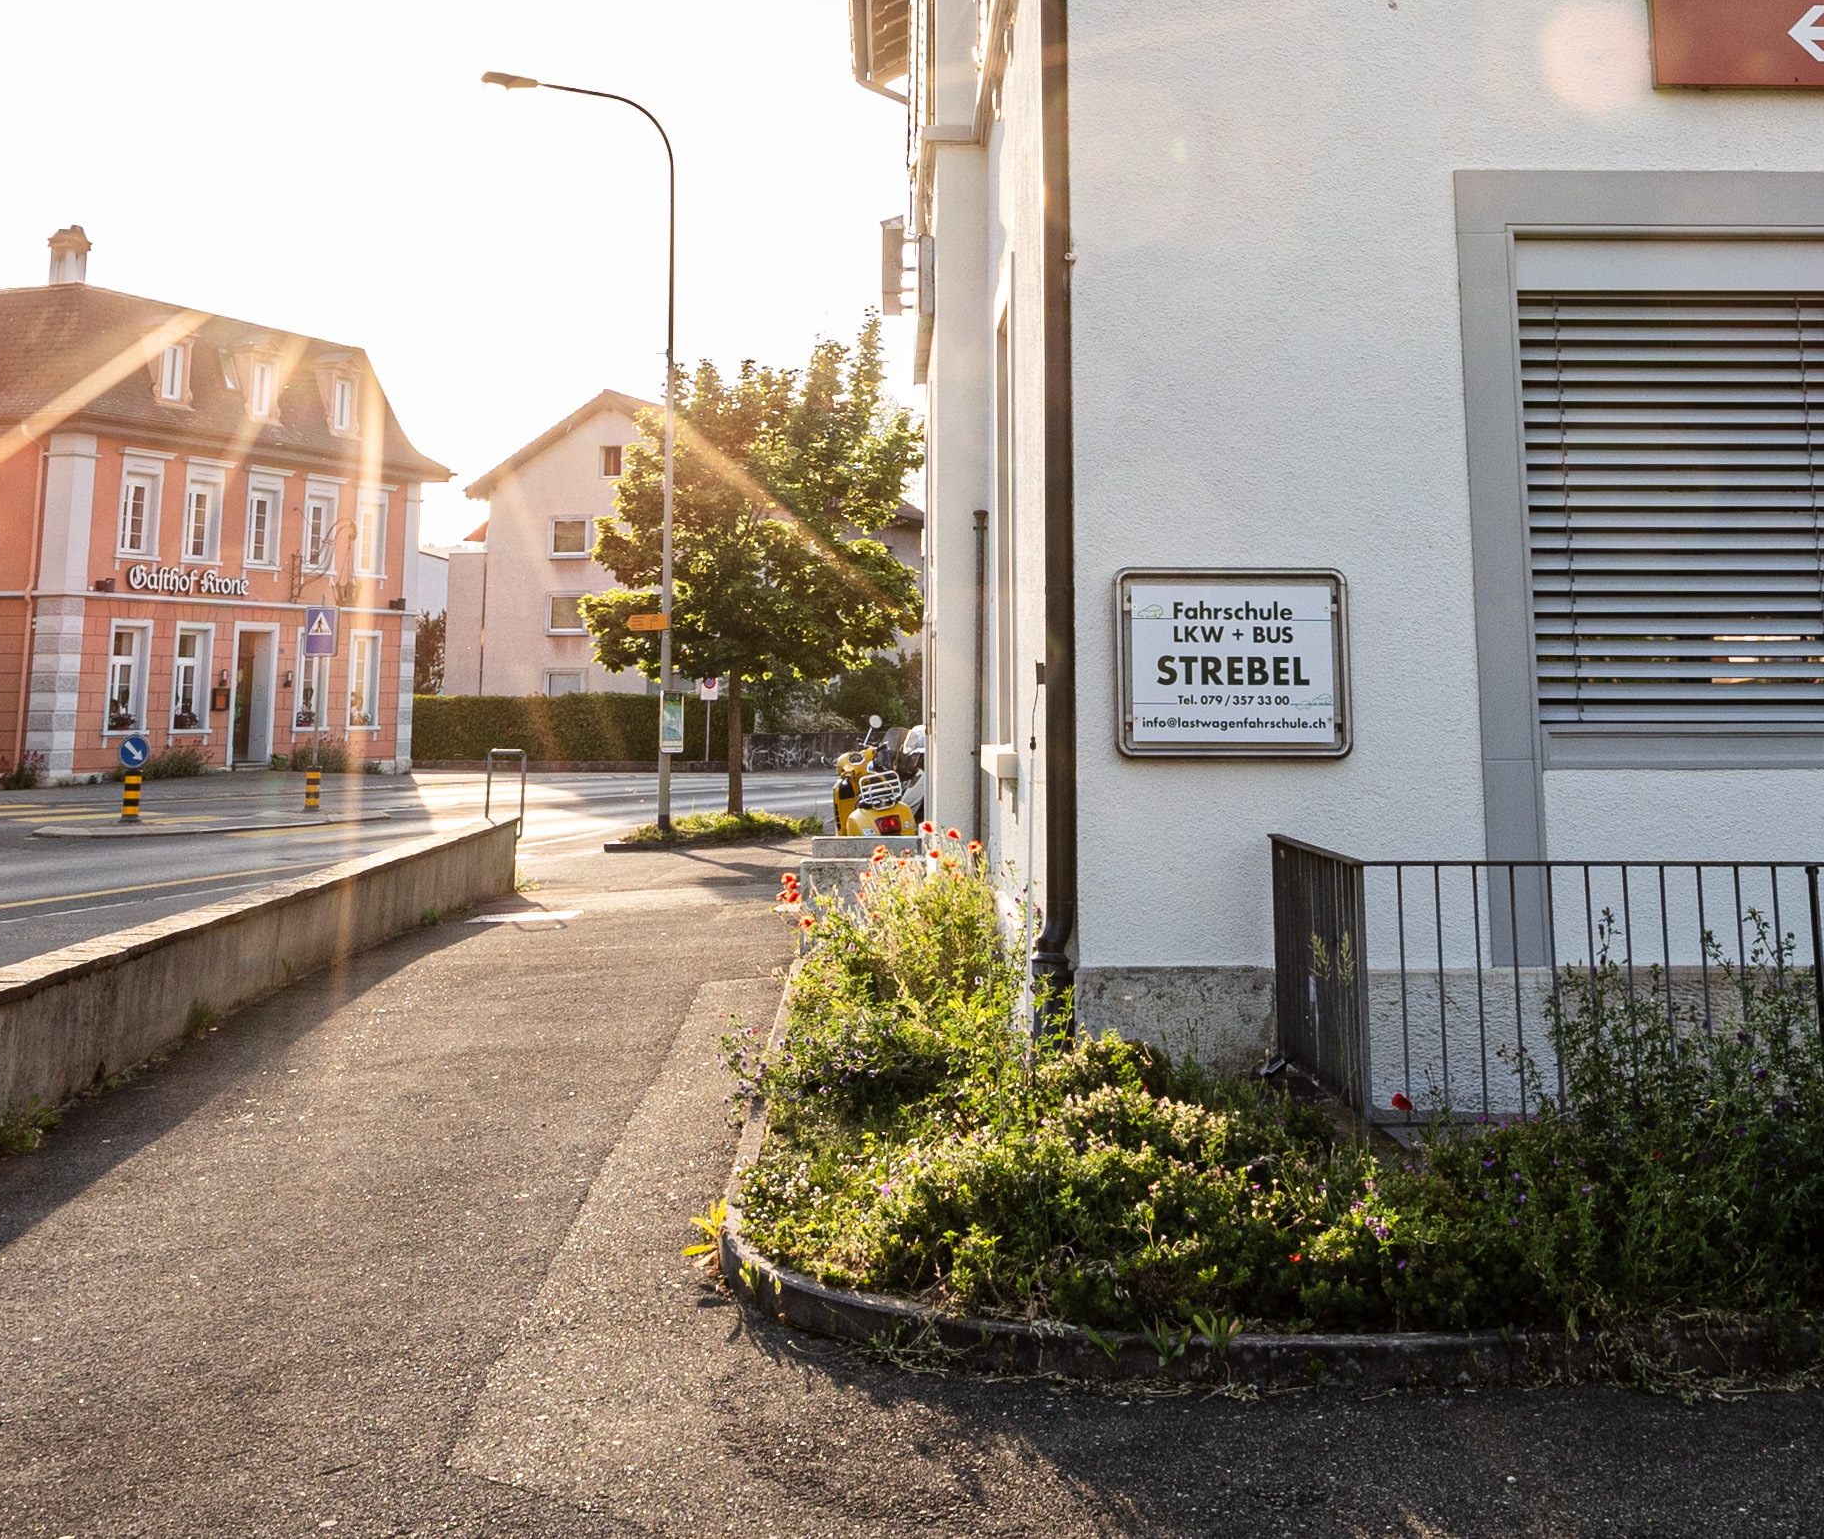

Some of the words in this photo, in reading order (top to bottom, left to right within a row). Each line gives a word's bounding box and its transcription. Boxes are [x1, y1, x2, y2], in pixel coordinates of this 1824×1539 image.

[200, 569, 250, 596] Krone
[1173, 601, 1293, 621] Fahrschule
[1173, 626, 1224, 643] LKW
[1232, 629, 1244, 641] +
[1253, 627, 1294, 643] BUS
[1157, 655, 1310, 686] STREBEL
[1178, 695, 1198, 705] Tel.
[1258, 696, 1272, 706] 33
[1275, 696, 1290, 706] 00
[1142, 717, 1327, 732] info@lastwagenfahrschule.ch
